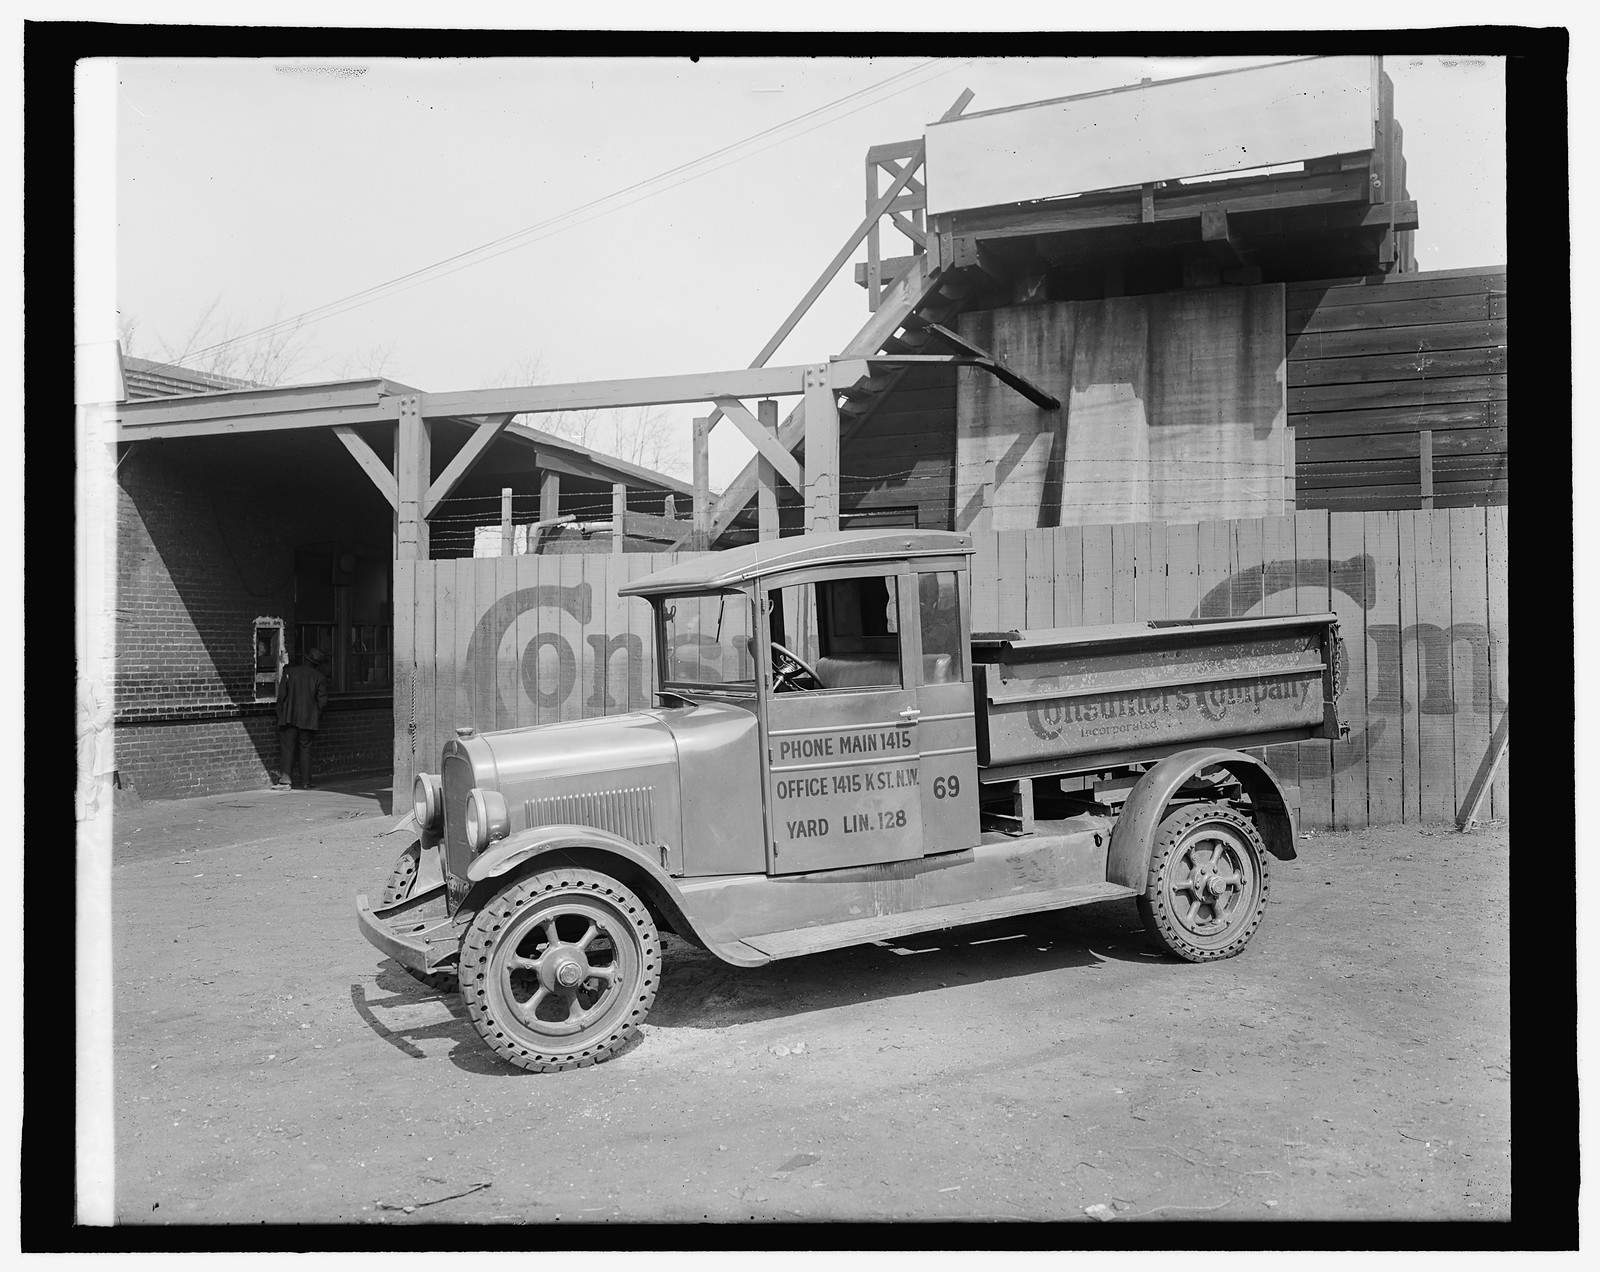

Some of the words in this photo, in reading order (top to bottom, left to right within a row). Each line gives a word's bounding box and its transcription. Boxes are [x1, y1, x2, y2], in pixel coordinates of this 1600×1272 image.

[1080, 718, 1157, 738] Incorporated
[780, 737, 834, 760] PHONE
[839, 733, 877, 755] MAIN
[880, 730, 912, 750] 1415
[776, 777, 829, 800] OFFICE
[832, 774, 862, 794] 1415
[865, 773, 875, 791] K
[877, 771, 895, 790] ST.
[933, 775, 960, 800] 69
[786, 818, 829, 839] YARD
[843, 813, 875, 834] LIN.
[877, 809, 907, 830] 128
